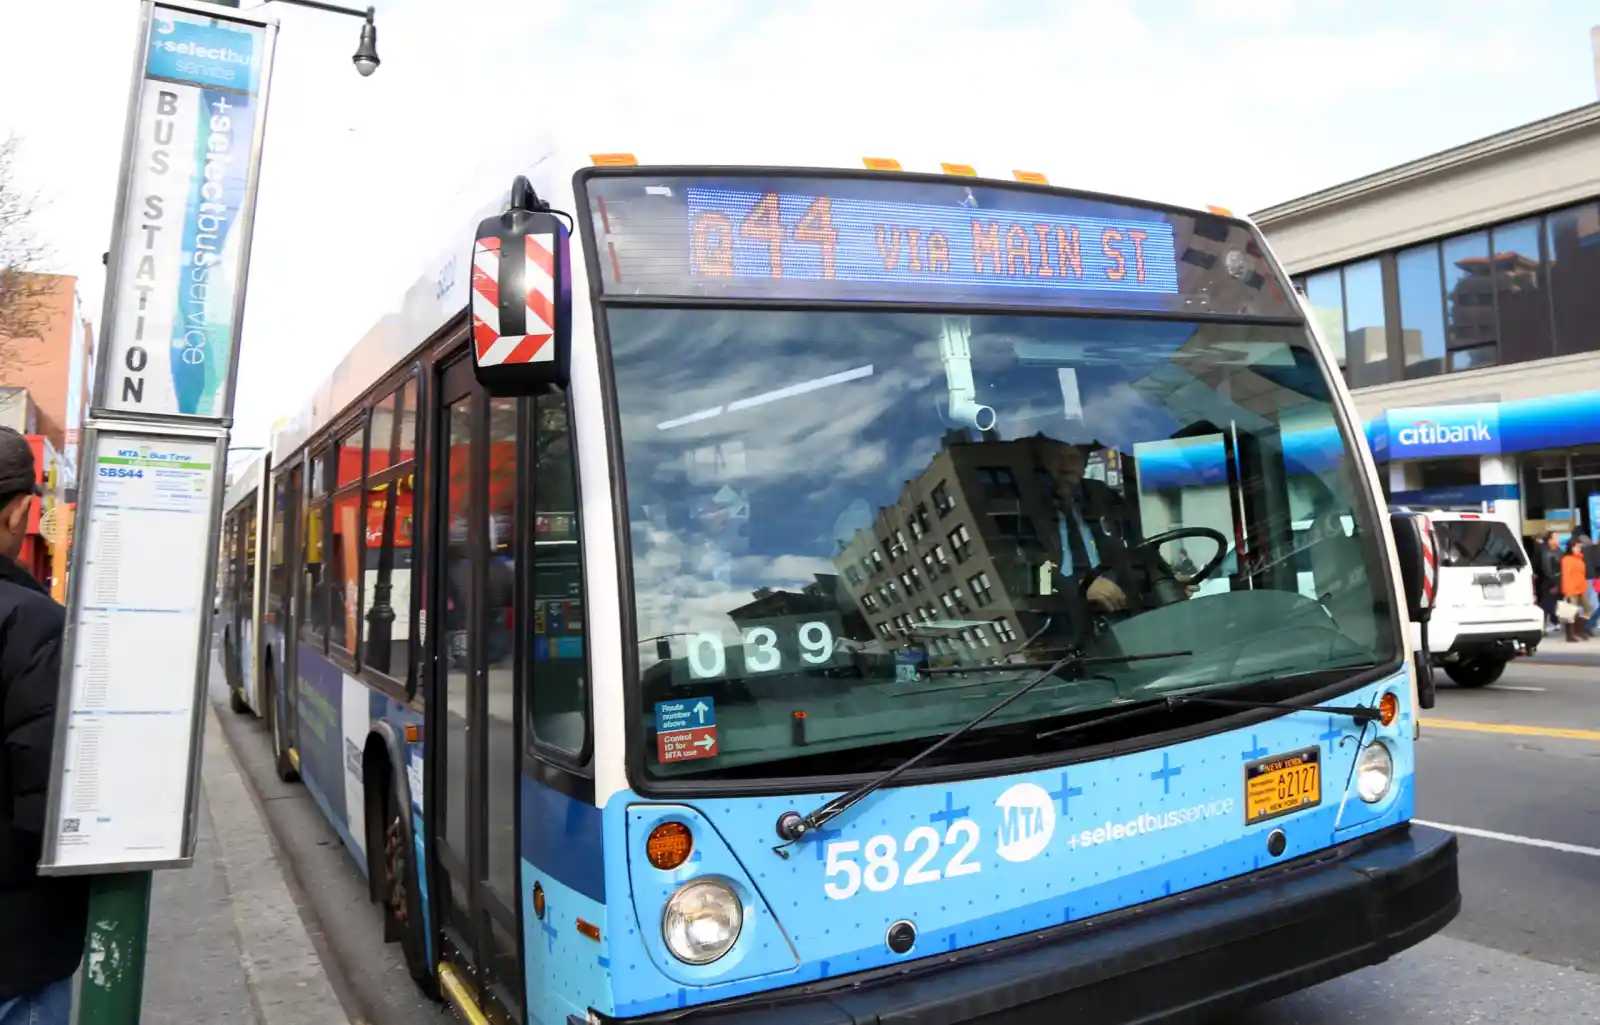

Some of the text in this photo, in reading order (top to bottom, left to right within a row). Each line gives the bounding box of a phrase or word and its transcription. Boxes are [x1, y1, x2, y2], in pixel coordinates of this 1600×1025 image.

[121, 91, 178, 403] BUS STATION
[875, 223, 950, 272] VIA
[971, 218, 1082, 280] MAIN
[1102, 229, 1148, 283] ST
[1399, 420, 1491, 446] citibank
[98, 467, 144, 479] SBS44
[661, 703, 685, 713] Route
[662, 711, 692, 721] number
[663, 720, 687, 729] above
[664, 734, 692, 743] Control
[664, 743, 674, 752] ID
[664, 751, 683, 760] MTA
[999, 805, 1045, 848] MTA
[824, 819, 982, 900] 5822
